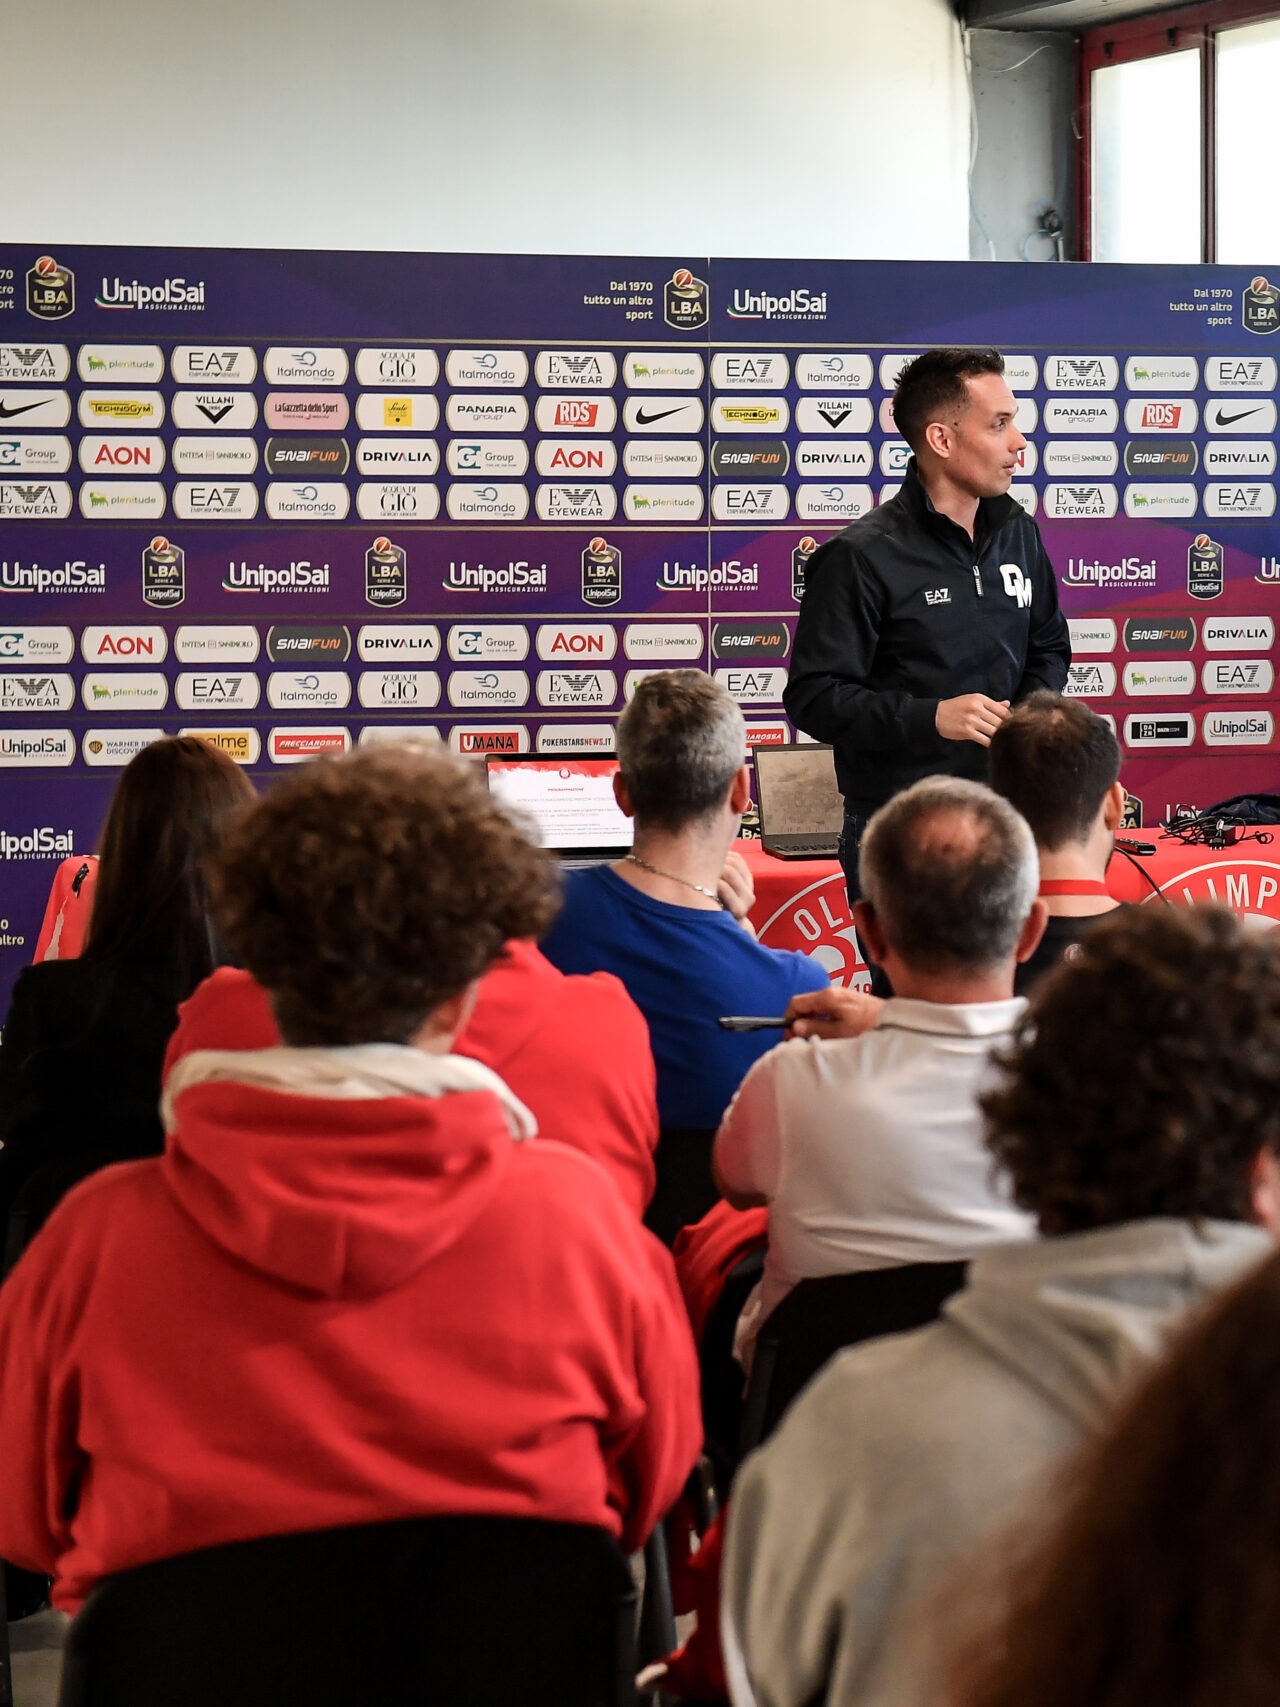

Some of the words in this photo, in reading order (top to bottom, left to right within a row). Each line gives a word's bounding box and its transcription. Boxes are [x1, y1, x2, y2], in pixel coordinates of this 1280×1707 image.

[610, 281, 627, 291] Dal
[628, 281, 653, 291] 1970
[33, 289, 70, 304] LBA
[102, 277, 205, 310] UnipolSai
[1193, 288, 1210, 298] Dal
[1211, 288, 1233, 298] 1970
[583, 295, 611, 305] tutto
[613, 297, 627, 305] un
[628, 295, 653, 306] altro
[734, 289, 828, 319] UnipolSai
[670, 301, 703, 315] LBA
[1170, 302, 1195, 311] tutto
[1210, 302, 1233, 312] altro
[625, 309, 653, 322] sport
[1248, 307, 1277, 320] LBA
[1207, 315, 1233, 327] sport
[188, 352, 239, 372] EA7
[277, 367, 335, 378] Italmondo
[652, 367, 695, 376] plenitude
[726, 359, 773, 377] EA7
[1219, 362, 1263, 379] EA7
[547, 375, 603, 384] EYEWEAR
[807, 372, 861, 382] Italmondo
[1151, 370, 1191, 378] plenitude
[1055, 379, 1106, 387] EYEWEAR
[195, 396, 234, 404] VILLANI
[817, 401, 852, 409] VILLANI
[282, 403, 307, 413] Gazzetta
[322, 403, 338, 414] Sport
[457, 405, 517, 414] PANARIA
[559, 402, 591, 422] RDS
[1053, 408, 1108, 416] PANARIA
[1146, 404, 1174, 423] RDS
[94, 444, 151, 465] AON
[363, 452, 432, 462] DRIVALIA
[484, 452, 514, 463] Group
[550, 448, 603, 468] AON
[801, 453, 866, 463] DRIVALIA
[1209, 453, 1270, 463] DRIVALIA
[149, 565, 179, 578] LBA
[587, 565, 616, 577] LBA
[1068, 557, 1157, 587] UnipolSai
[1192, 561, 1219, 572] LBA
[2, 561, 106, 593] UnipolSai
[229, 561, 330, 592] UnipolSai
[450, 561, 547, 592] UnipolSai
[663, 561, 758, 592] UnipolSai
[924, 587, 949, 601] EA7
[1207, 629, 1268, 639] DRIVALIA
[364, 638, 433, 649] DRIVALIA
[727, 672, 774, 692] EA7
[1149, 674, 1188, 683] plenitude
[280, 691, 338, 701] Italmondo
[548, 693, 603, 702] EYEWEAR
[1213, 719, 1267, 737] UnipolSai
[1, 737, 66, 757] UnipolSai
[278, 739, 342, 748] FRECCIAROSSA
[463, 734, 514, 751] UMANA
[541, 737, 612, 747] POKERSTARSNEWS.IT
[0, 827, 73, 860] ipolSai
